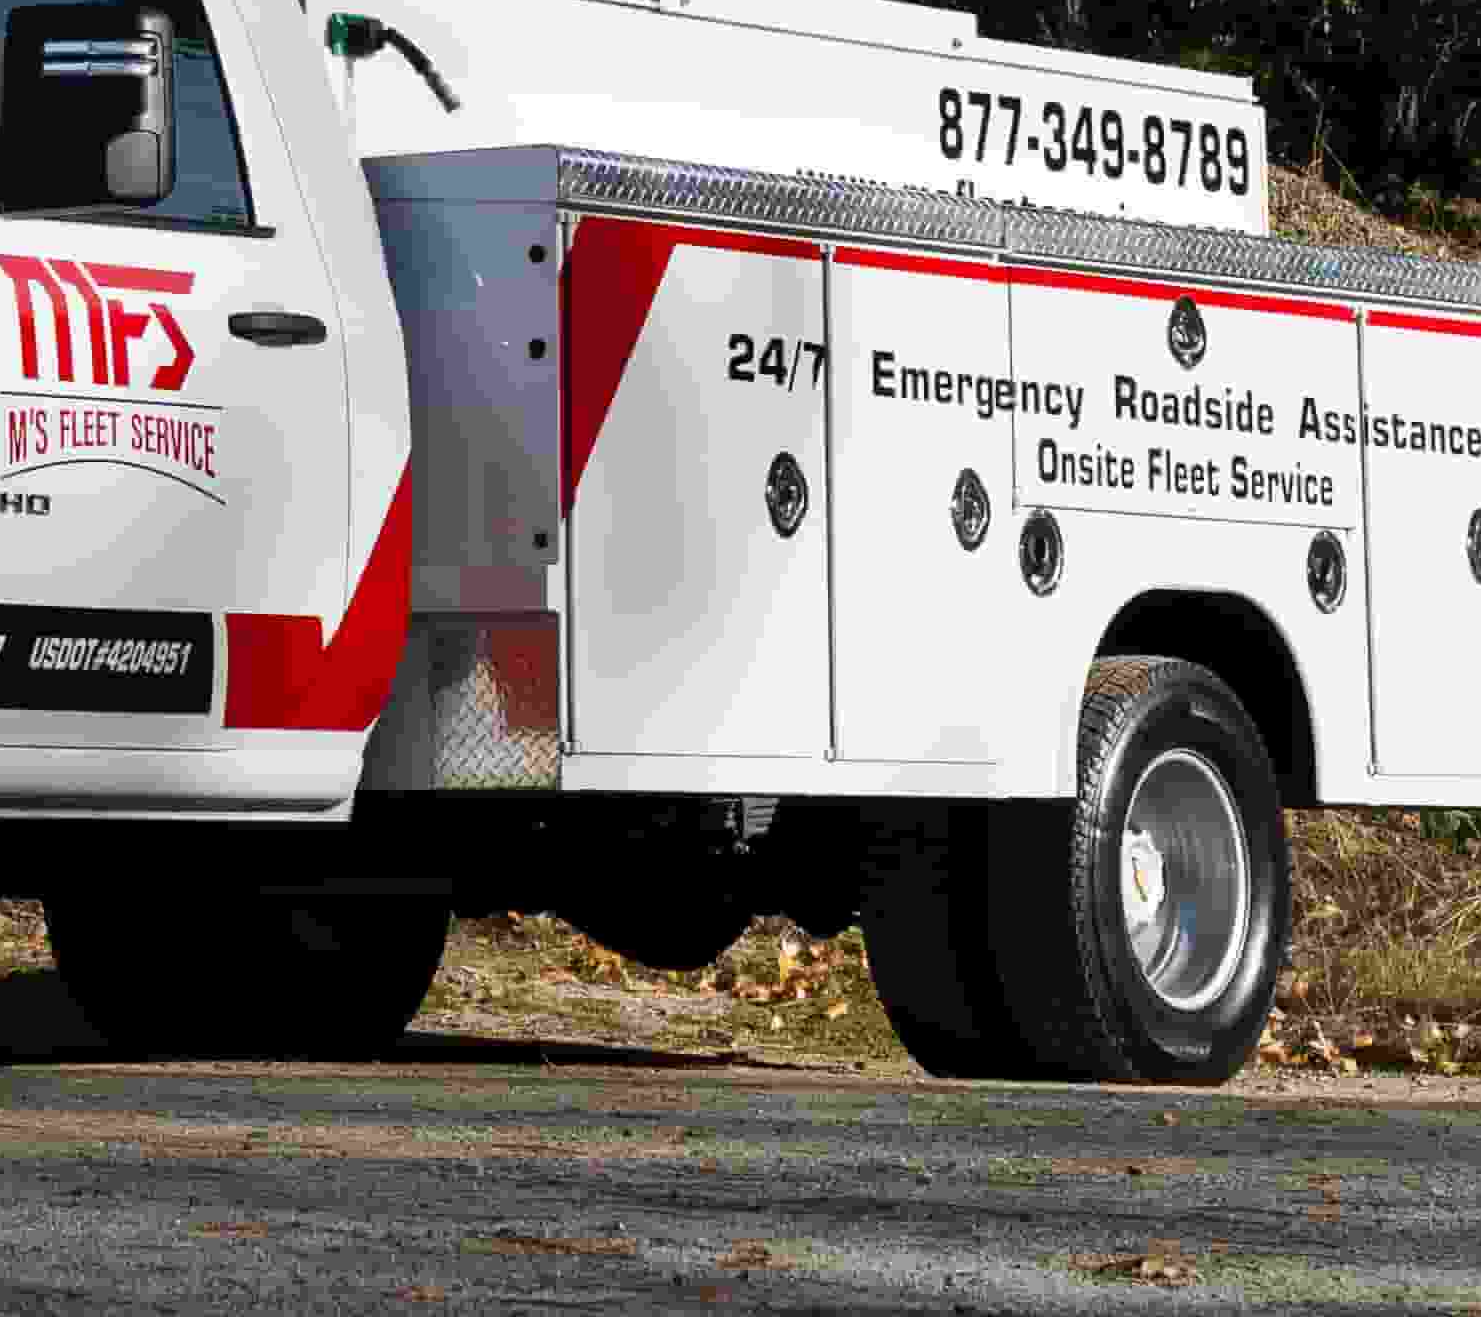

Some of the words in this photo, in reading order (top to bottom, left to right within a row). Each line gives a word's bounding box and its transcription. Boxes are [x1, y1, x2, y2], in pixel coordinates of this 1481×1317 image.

[939, 86, 1249, 195] 877-349-8789
[727, 332, 826, 392] 24/7
[872, 349, 1084, 429] Emergency
[1113, 374, 1274, 435] Roadside
[8, 407, 49, 464] M'S
[59, 409, 121, 449] FLEET
[131, 413, 217, 478] SERVICE
[1037, 437, 1135, 489] Onsite
[1147, 447, 1220, 496] Fleet
[1230, 455, 1334, 507] Service
